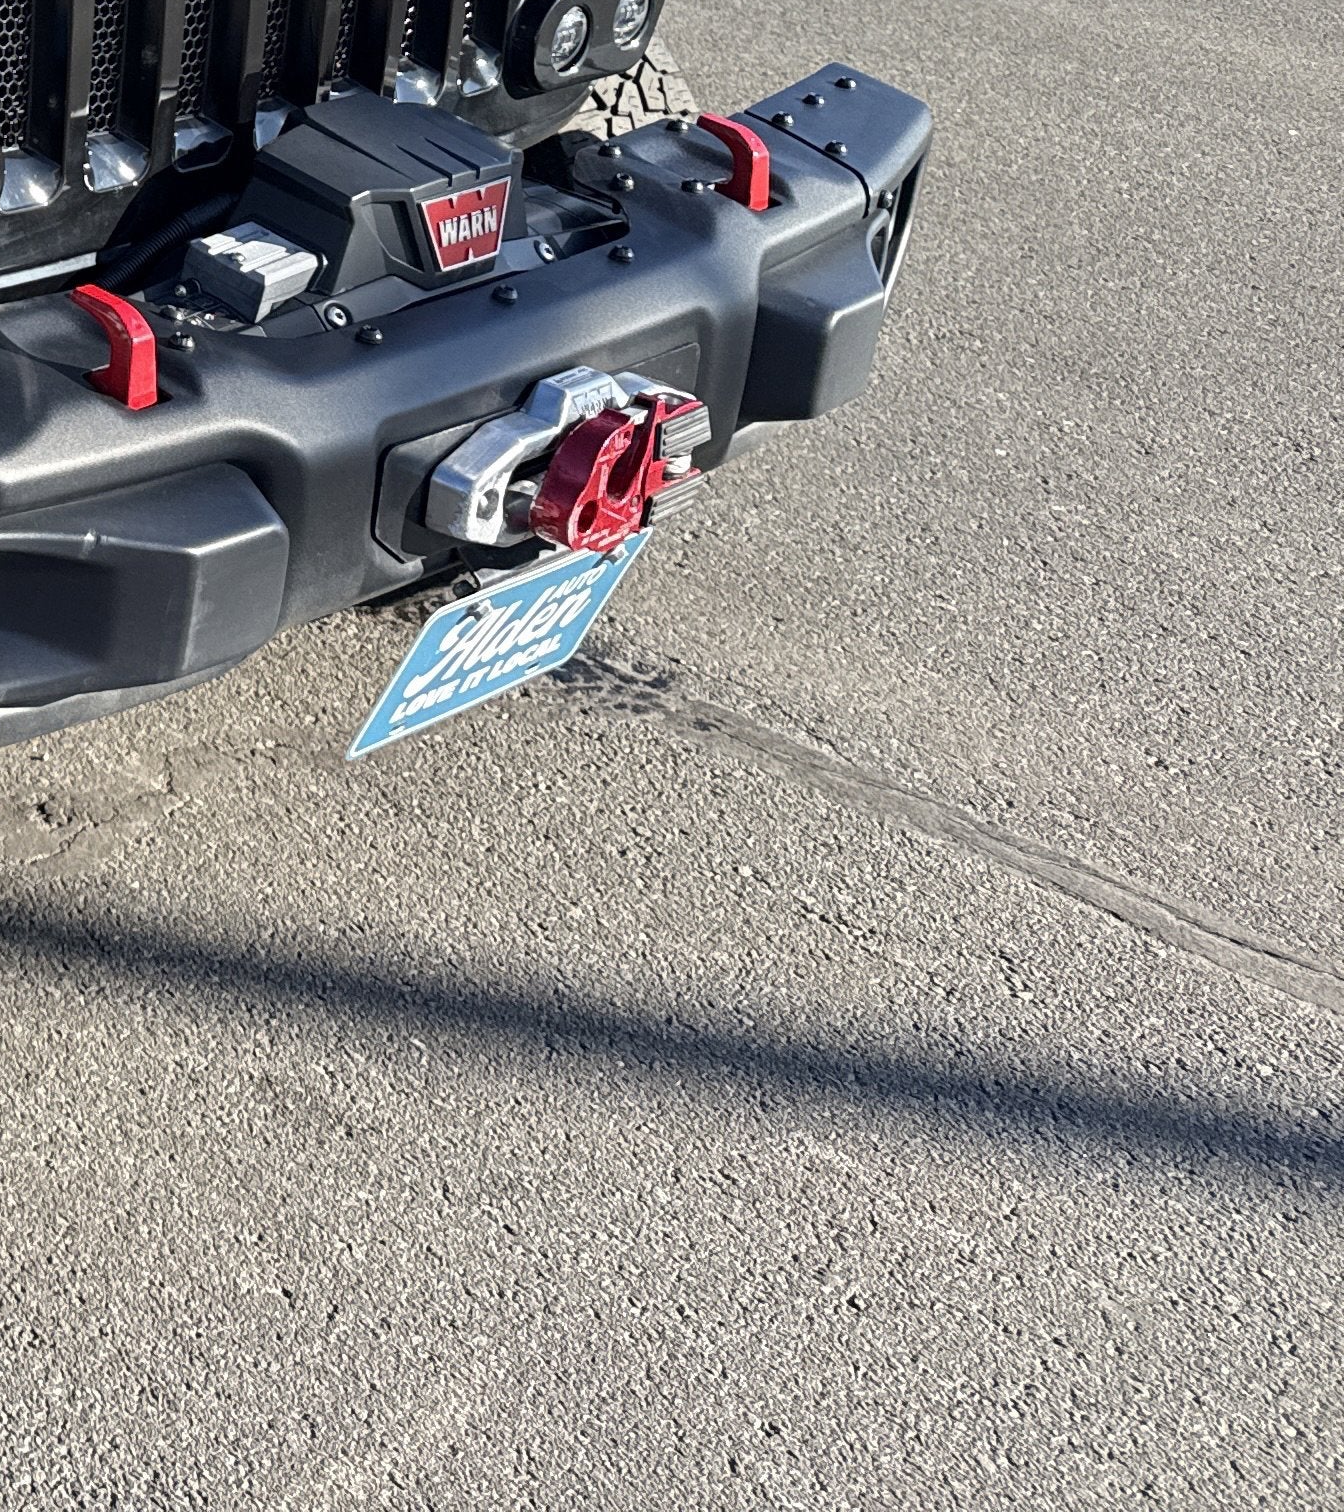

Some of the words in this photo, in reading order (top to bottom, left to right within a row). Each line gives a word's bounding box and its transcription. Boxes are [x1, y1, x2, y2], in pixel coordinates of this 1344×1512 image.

[438, 205, 498, 248] WARN
[547, 563, 608, 604] AUTO
[403, 586, 592, 699] Alden
[389, 678, 461, 725] LOVE
[458, 665, 491, 694] IT
[486, 633, 563, 683] LOCAL
